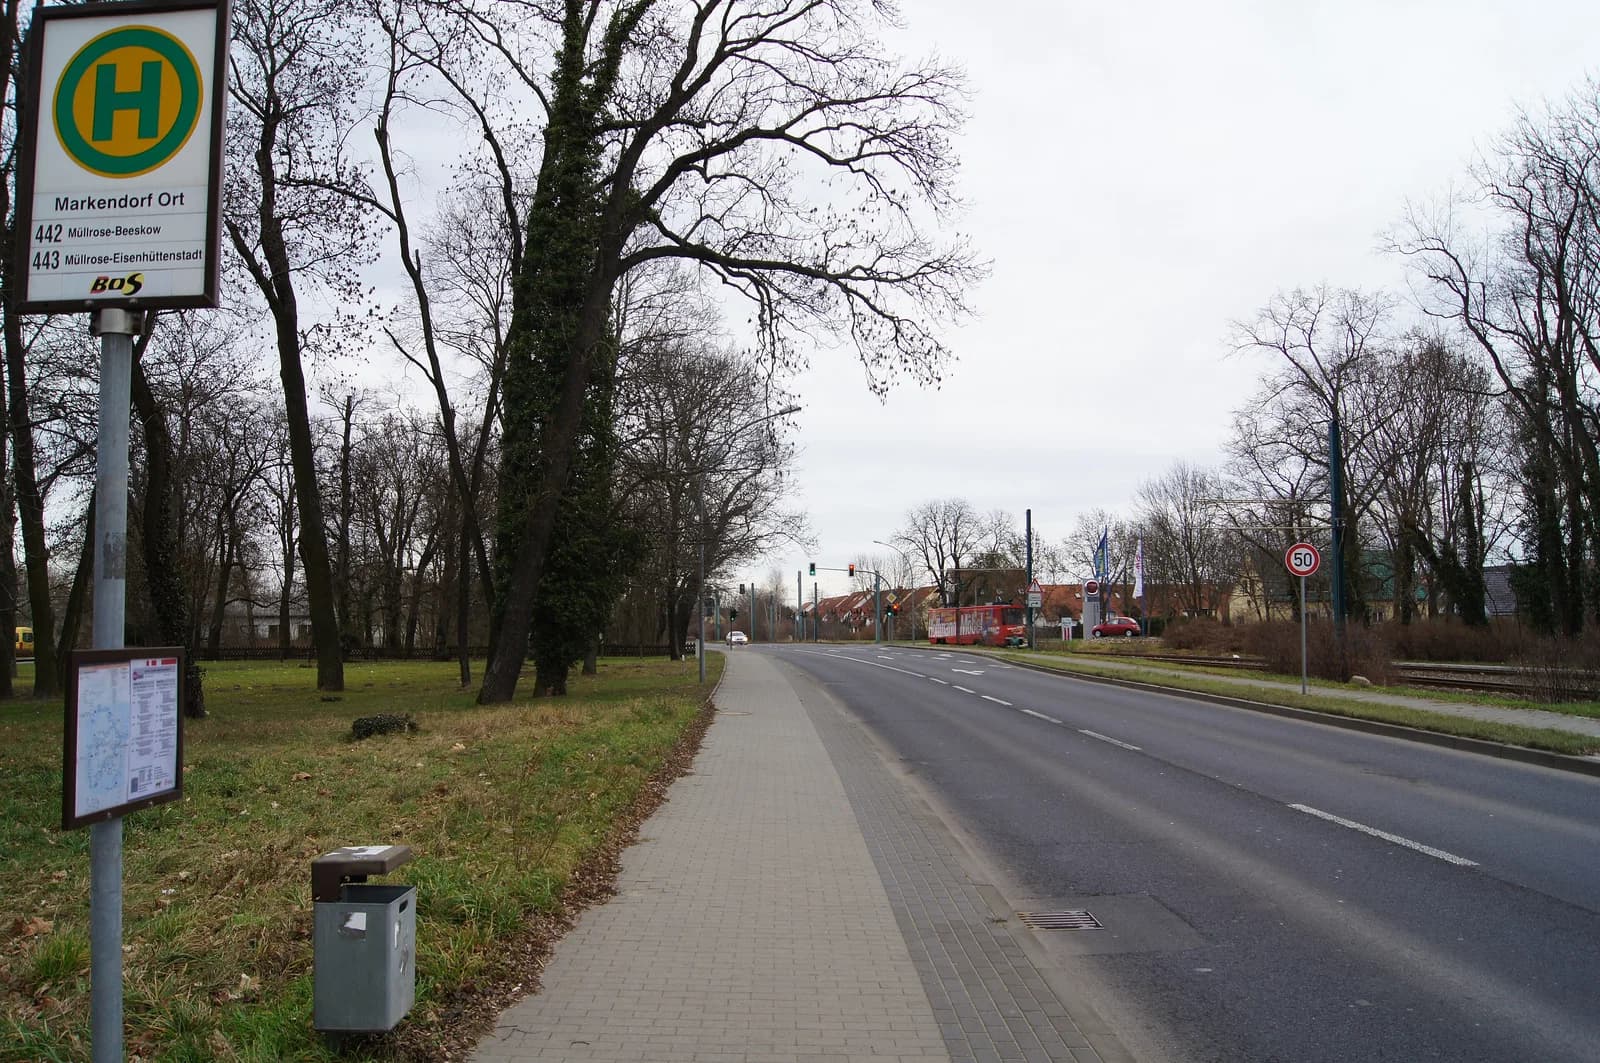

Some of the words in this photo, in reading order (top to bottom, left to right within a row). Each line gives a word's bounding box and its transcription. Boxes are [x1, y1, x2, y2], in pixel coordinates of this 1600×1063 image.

[92, 60, 162, 141] H
[55, 193, 153, 211] Markendorf
[158, 192, 185, 206] Ort
[35, 224, 63, 243] 442
[68, 226, 161, 238] Müllrose-Beeskow
[32, 250, 60, 270] 443
[65, 250, 202, 266] Müllrose-Eisenhüttenstadt
[1294, 552, 1312, 567] 50
